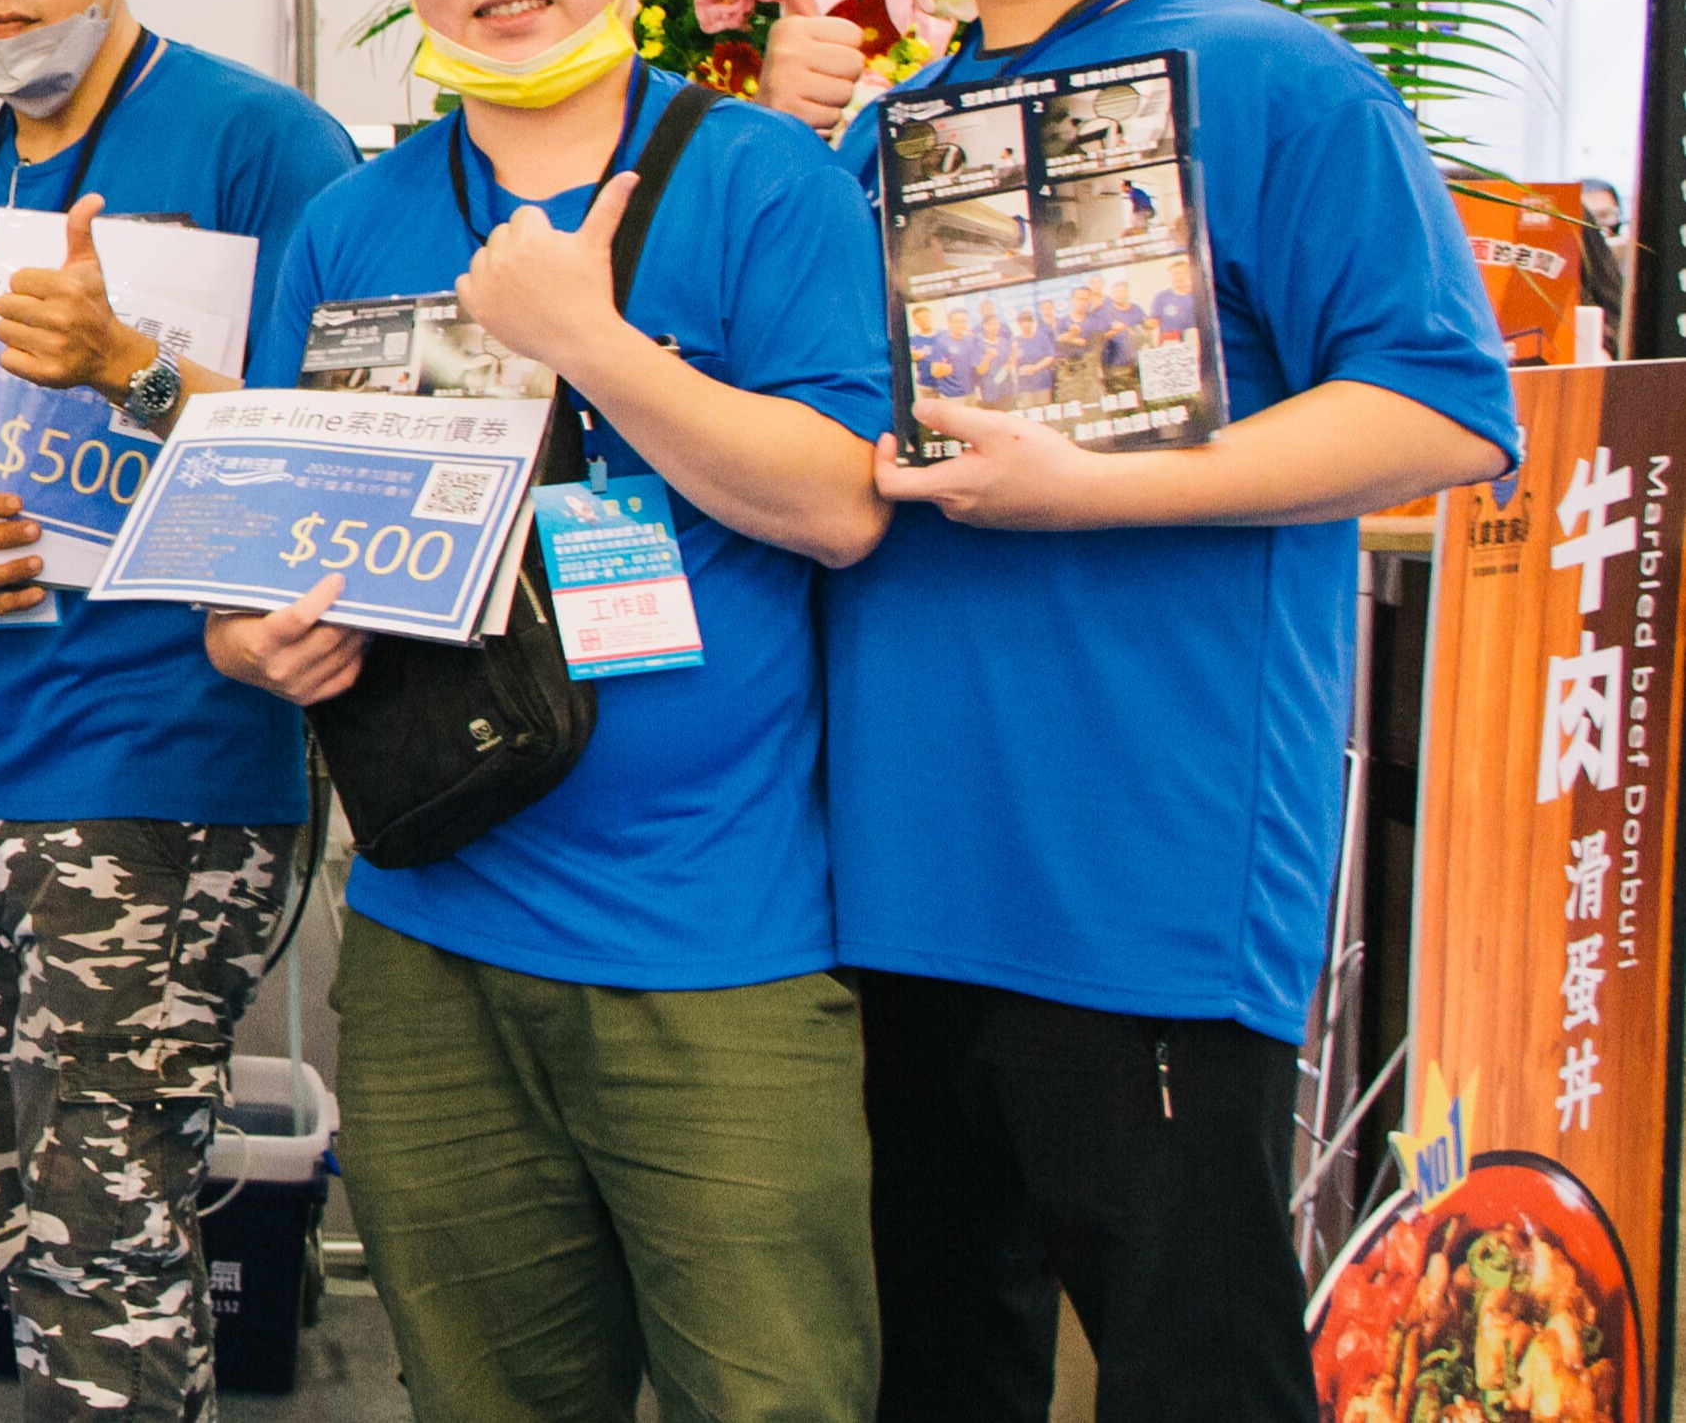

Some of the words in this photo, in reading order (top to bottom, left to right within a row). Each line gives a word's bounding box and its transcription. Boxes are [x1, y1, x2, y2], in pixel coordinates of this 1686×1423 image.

[1032, 100, 1045, 115] 2
[206, 404, 510, 446] 掃描+line索取折價券
[278, 511, 455, 583] $500
[1634, 453, 1674, 650] Marbled
[1536, 444, 1640, 806] 牛肉
[1624, 665, 1654, 769] beef
[1615, 784, 1649, 971] Donburi
[1553, 827, 1612, 1133] 滑蛋丼
